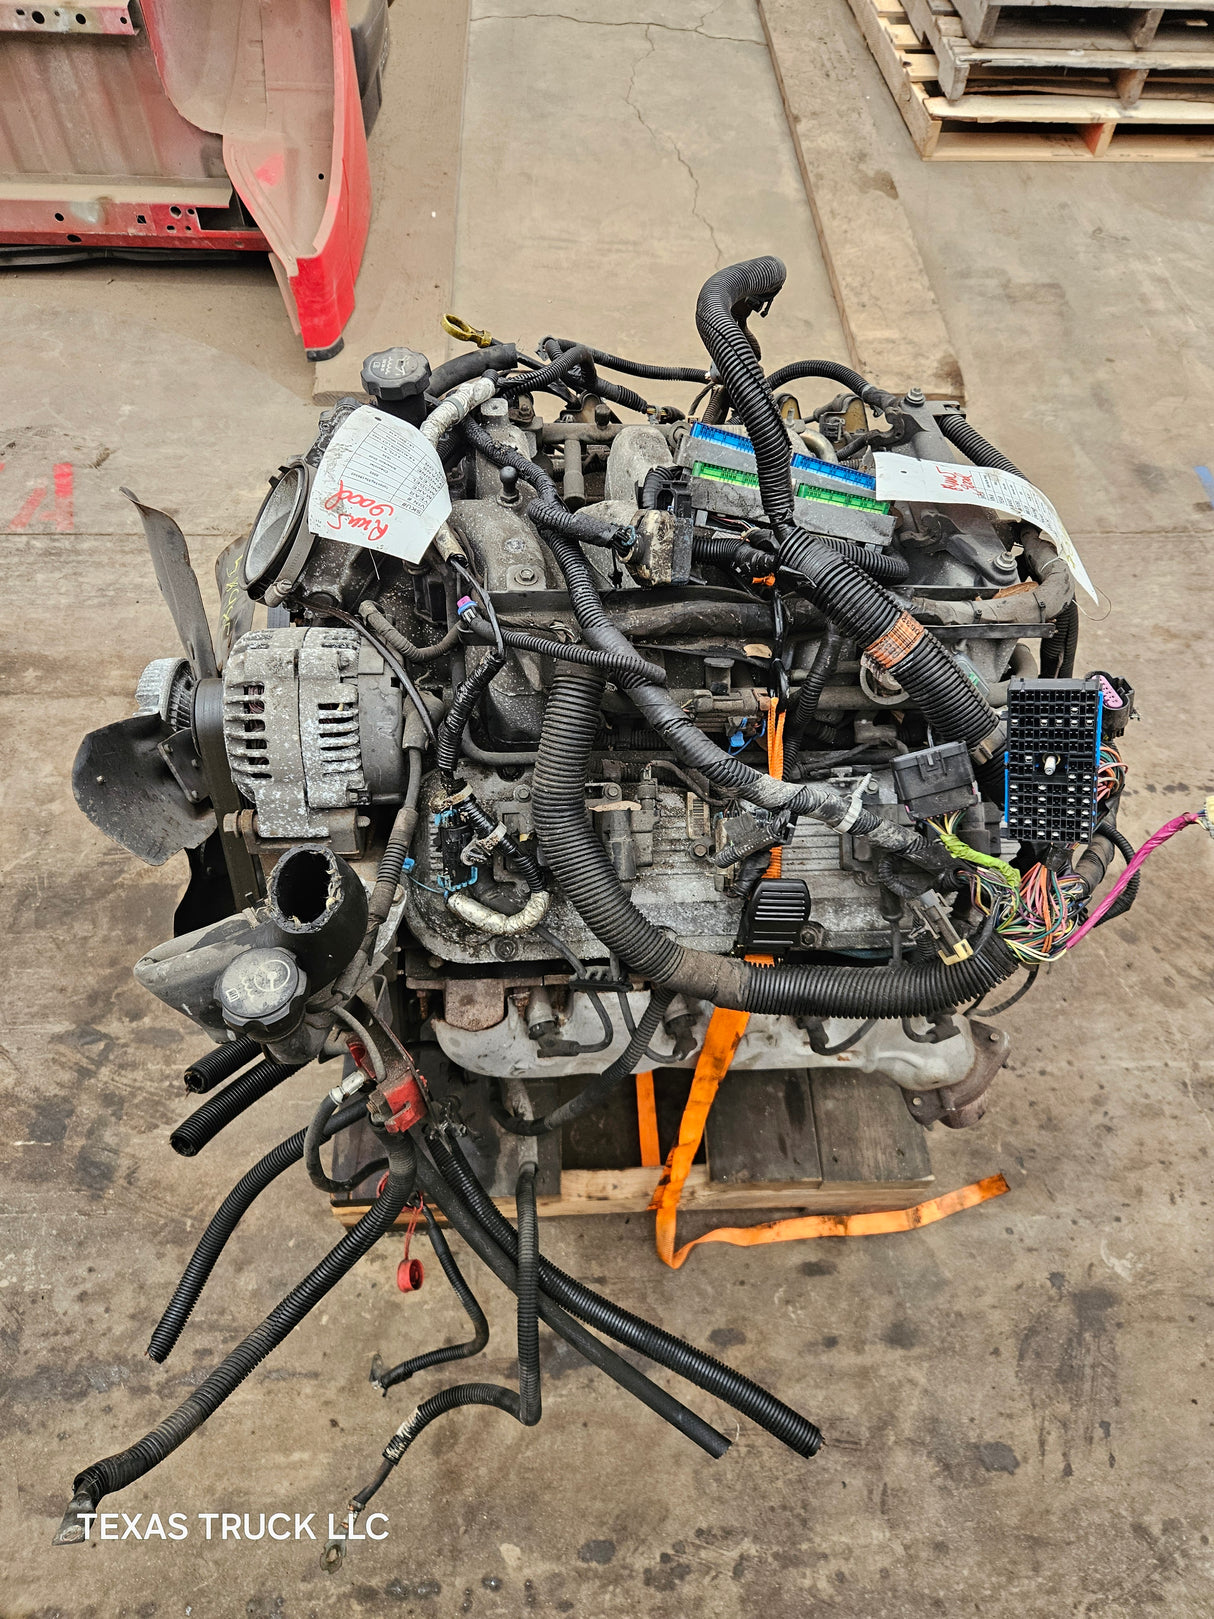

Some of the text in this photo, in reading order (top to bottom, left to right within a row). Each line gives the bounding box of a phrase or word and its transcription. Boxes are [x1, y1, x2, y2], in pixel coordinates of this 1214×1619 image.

[410, 490, 428, 504] YEAR
[402, 502, 421, 514] SKU#
[413, 500, 425, 509] VIN
[326, 512, 388, 541] Runs
